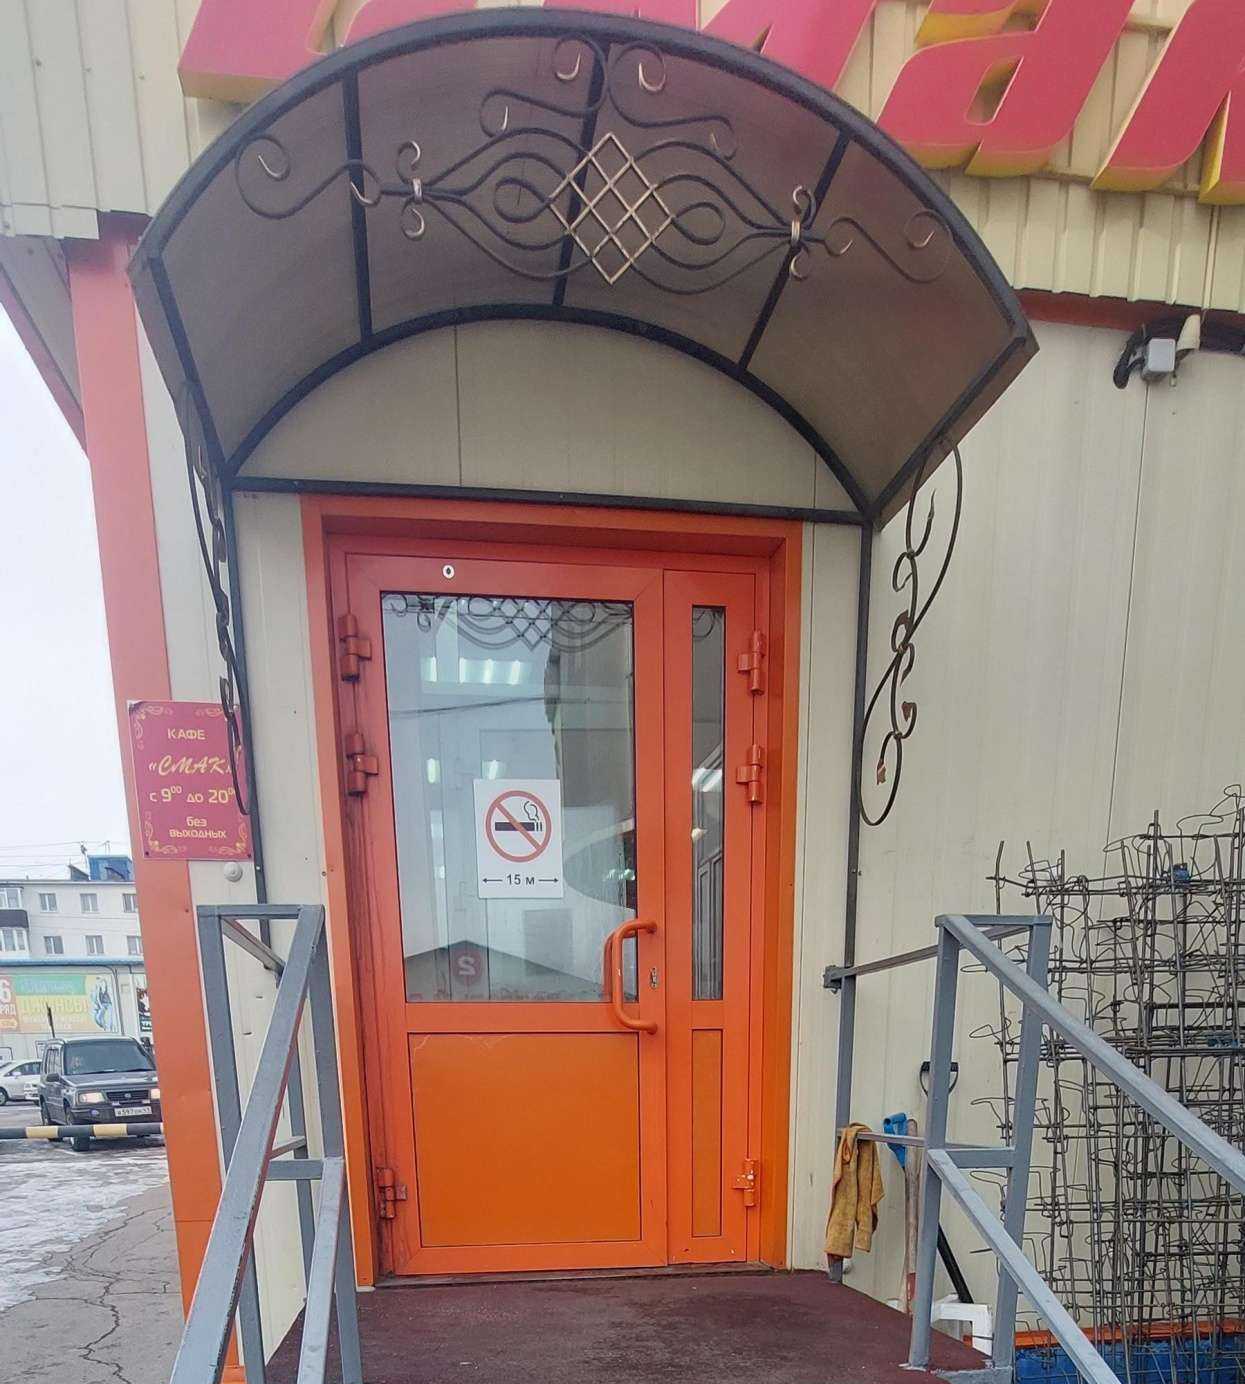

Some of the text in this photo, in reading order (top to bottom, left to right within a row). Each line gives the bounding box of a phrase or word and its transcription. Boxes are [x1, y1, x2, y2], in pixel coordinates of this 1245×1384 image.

[167, 728, 206, 741] КАФЕ
[187, 793, 204, 803] до
[186, 816, 208, 828] без
[169, 829, 227, 839] выходных
[506, 874, 521, 885] 15
